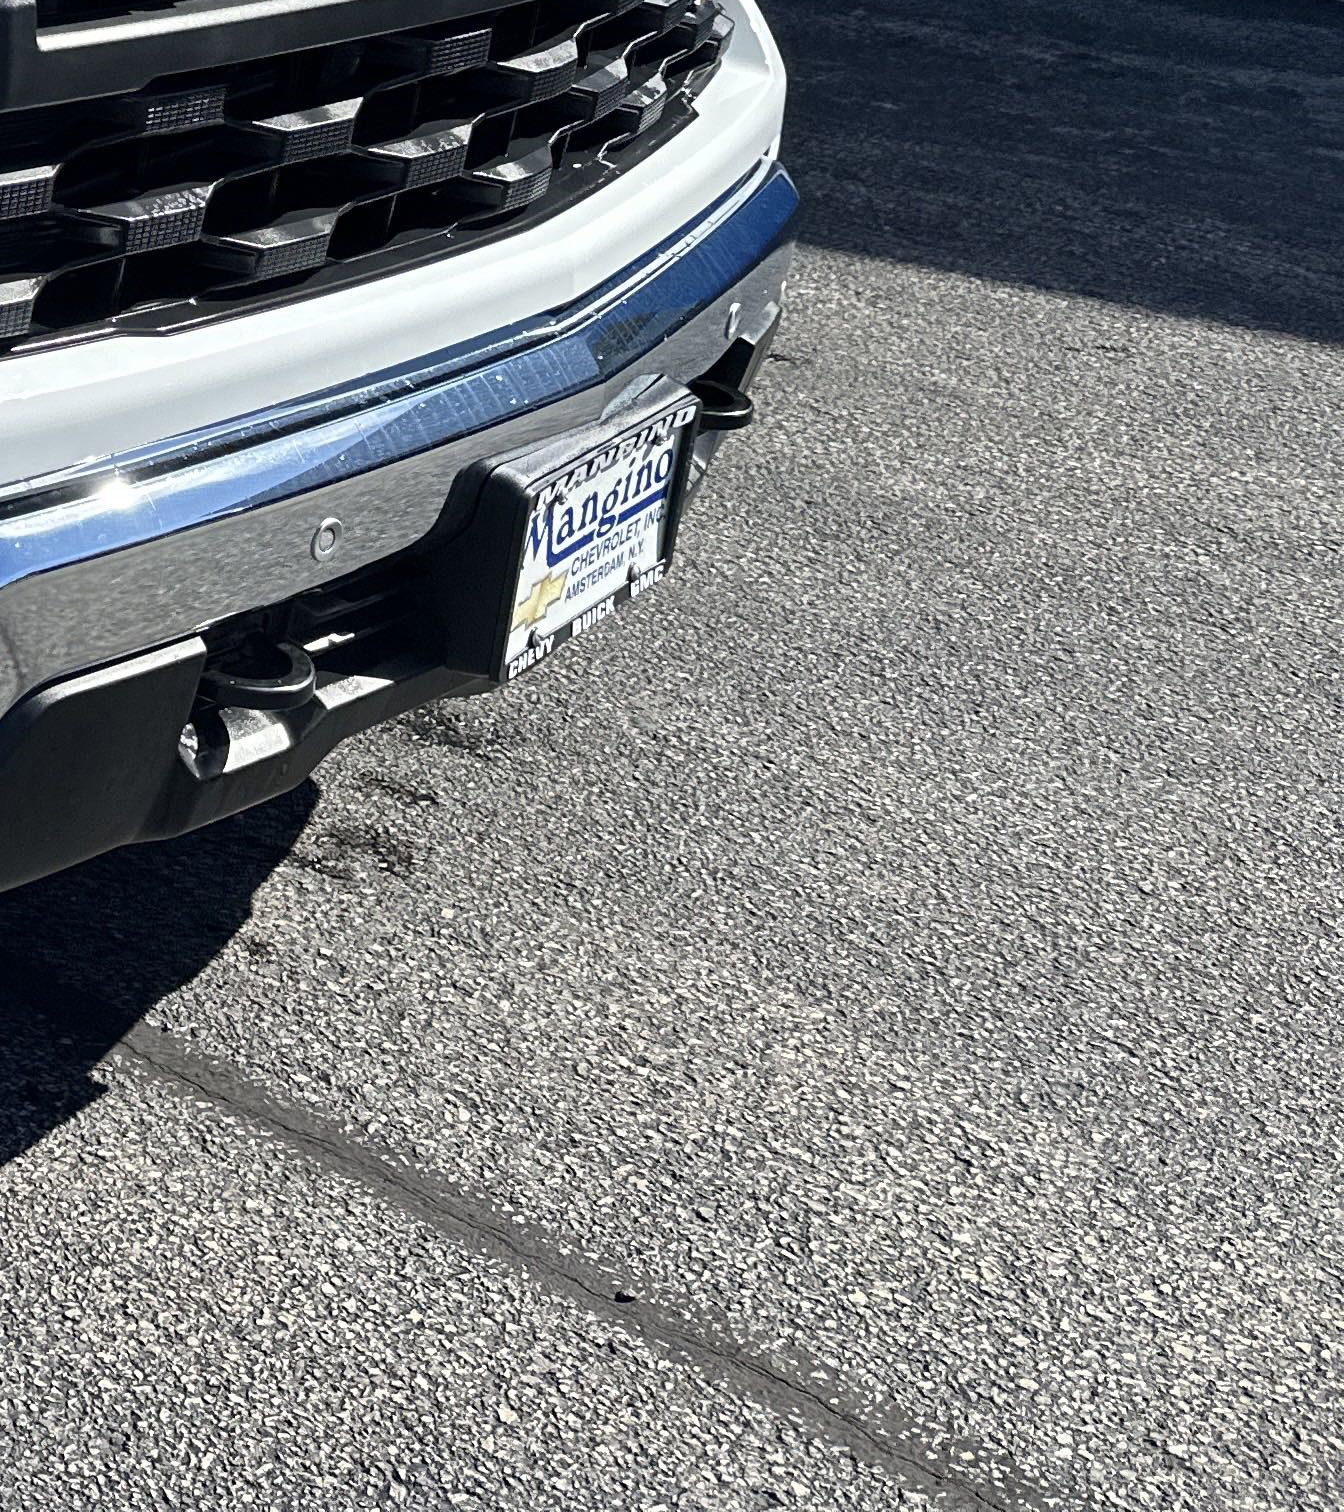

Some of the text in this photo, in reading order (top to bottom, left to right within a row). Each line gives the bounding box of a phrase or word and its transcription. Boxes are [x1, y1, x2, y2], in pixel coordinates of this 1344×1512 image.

[522, 448, 673, 568] Mangino
[508, 565, 664, 680] CHEVY BUICK GMC
